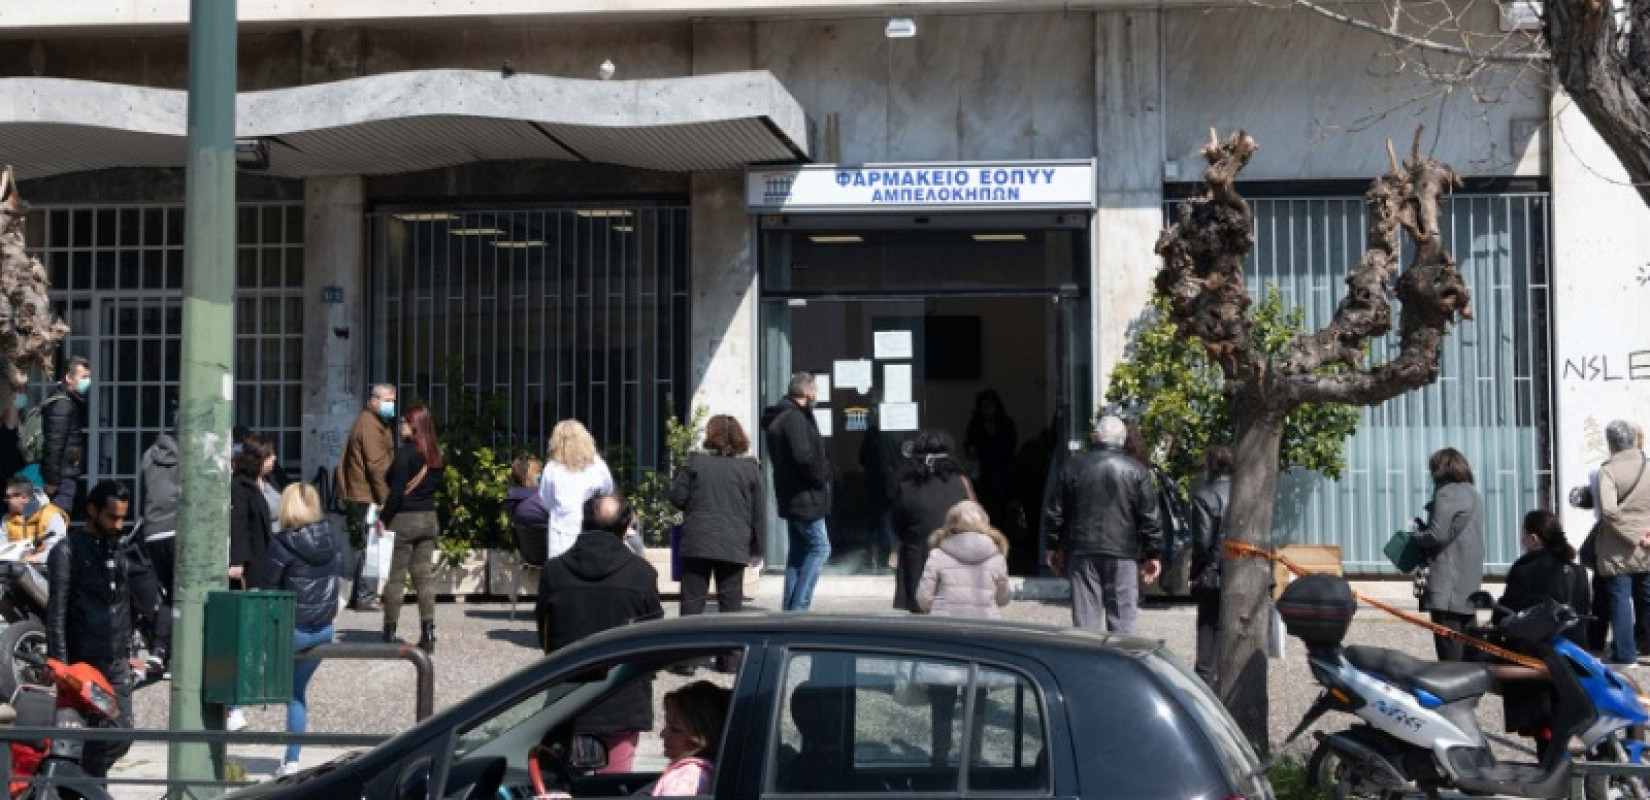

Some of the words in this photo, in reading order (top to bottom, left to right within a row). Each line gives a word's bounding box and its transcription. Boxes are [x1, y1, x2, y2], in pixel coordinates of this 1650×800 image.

[835, 169, 971, 186] ΦΑΡΜΑΚΕΙΟ
[979, 168, 1056, 185] ΕΟΠΥΥ
[871, 187, 1020, 202] ΑΜΠΕΛΟΚΗΠΩΝ
